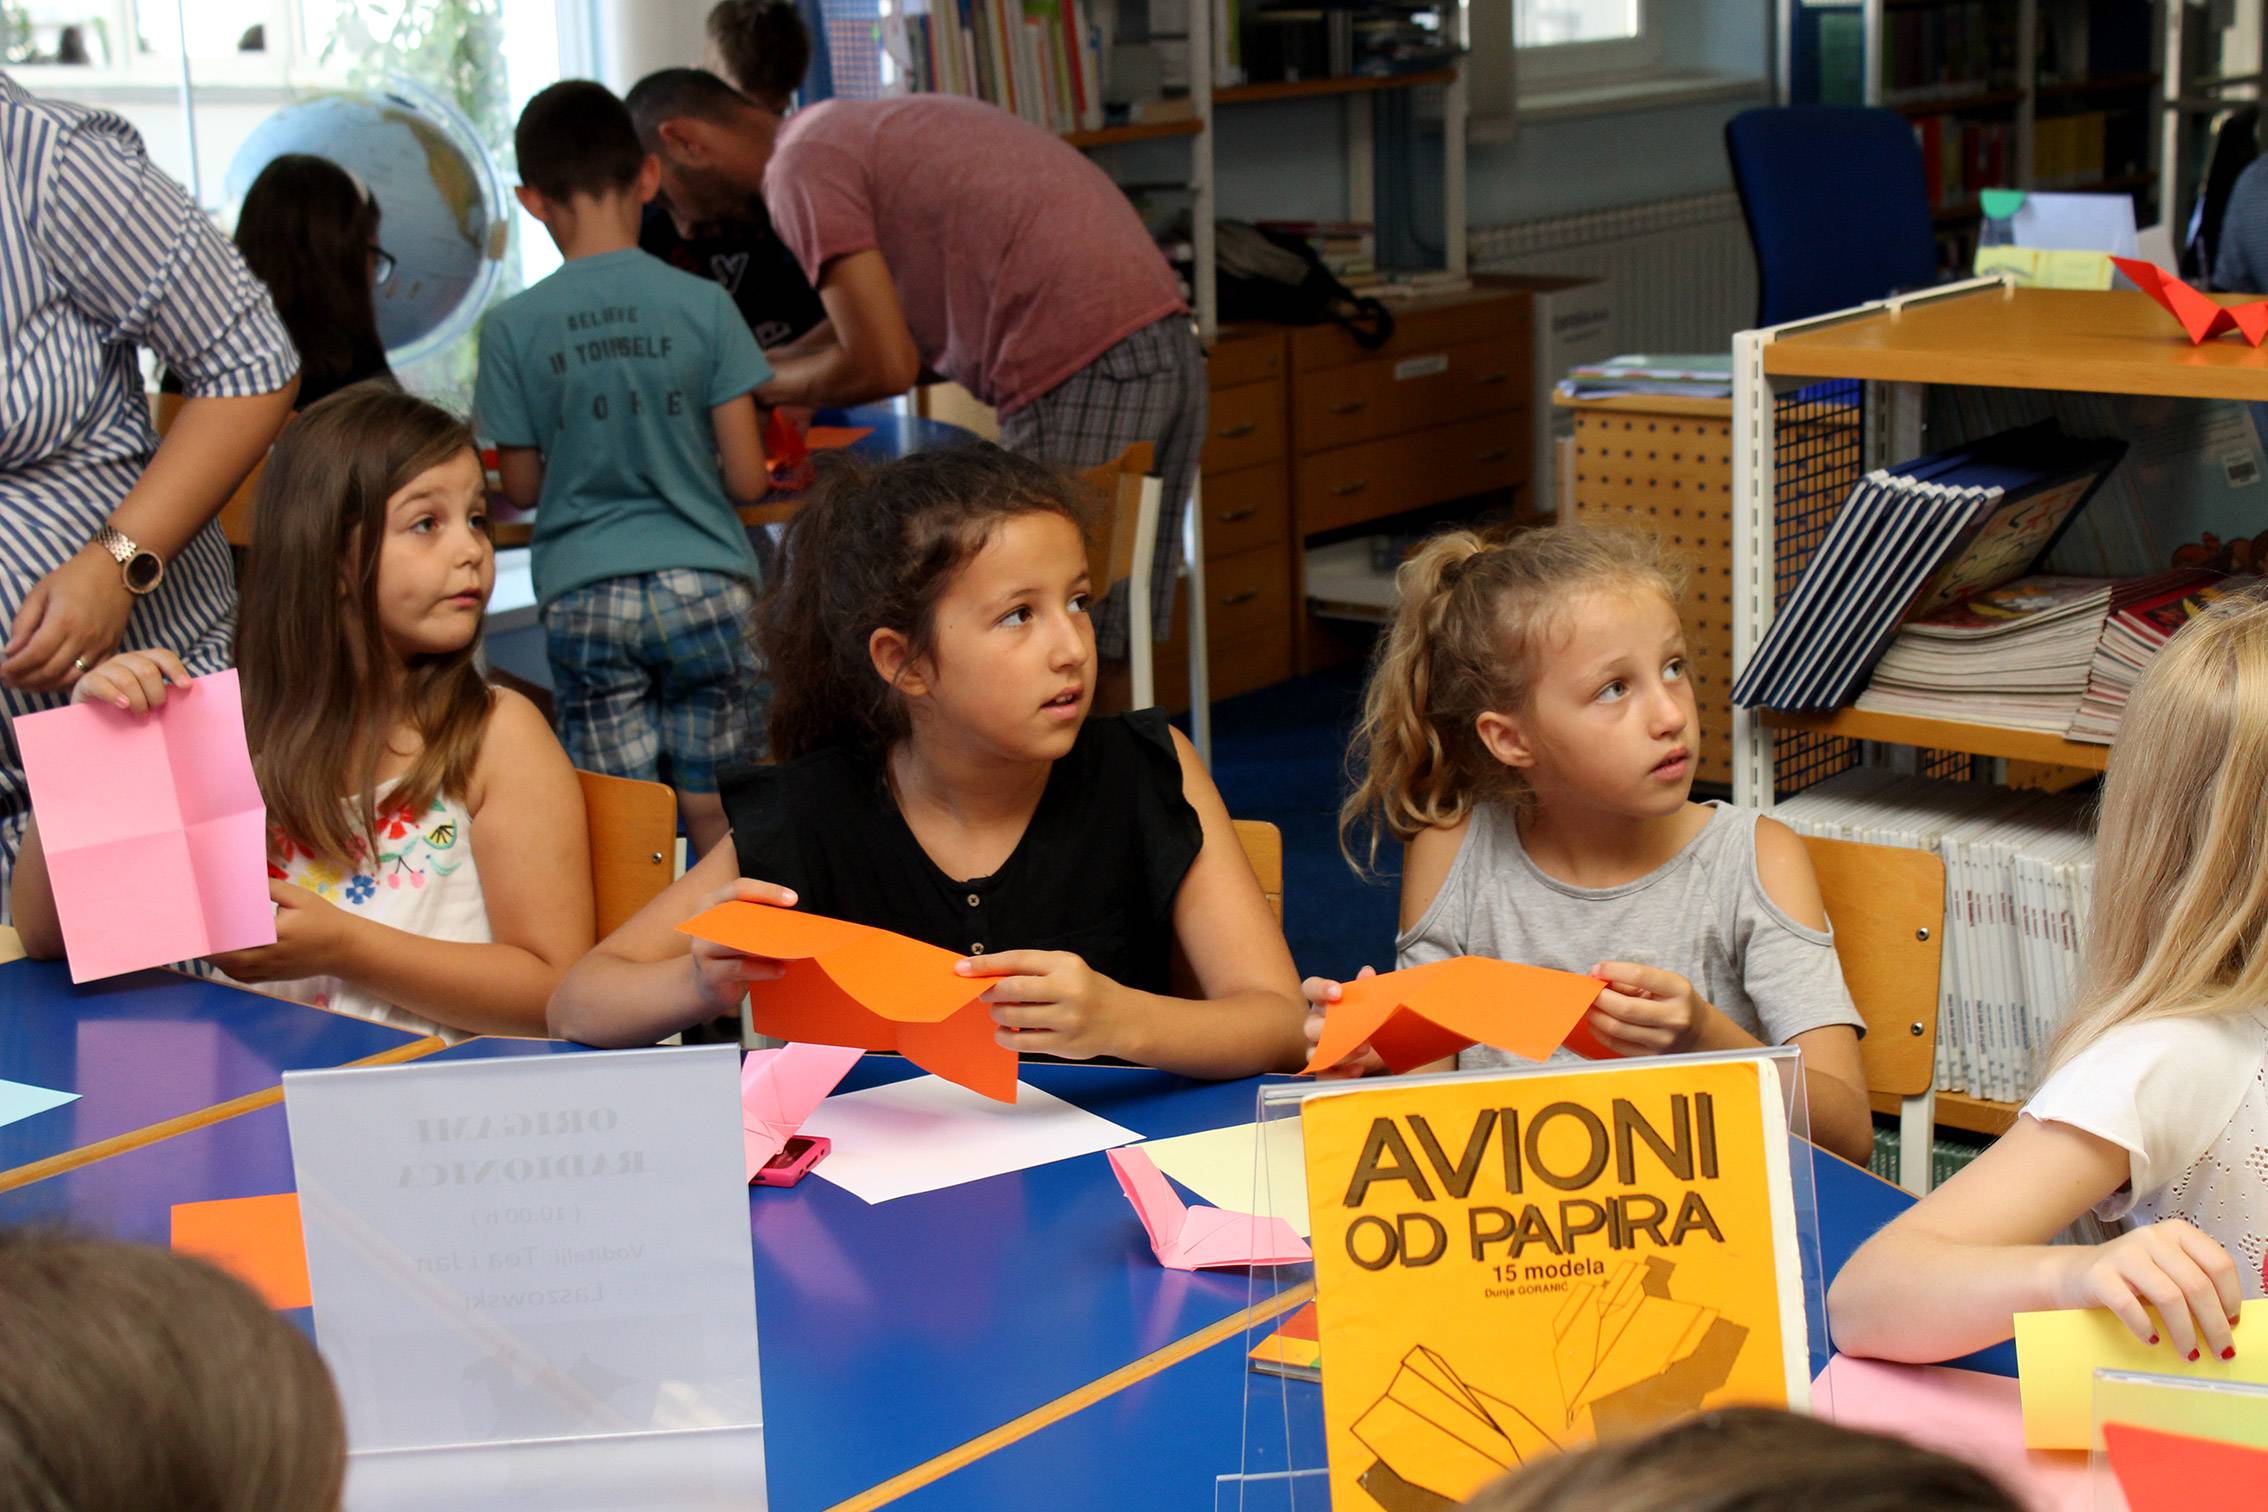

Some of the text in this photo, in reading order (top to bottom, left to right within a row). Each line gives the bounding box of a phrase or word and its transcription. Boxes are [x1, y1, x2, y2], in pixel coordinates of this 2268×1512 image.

[1342, 1091, 1719, 1207] AVIONI
[1345, 1190, 1726, 1271] OD PAPIRA
[1484, 1286, 1516, 1299] Dunja
[1493, 1258, 1605, 1283] 15 modela
